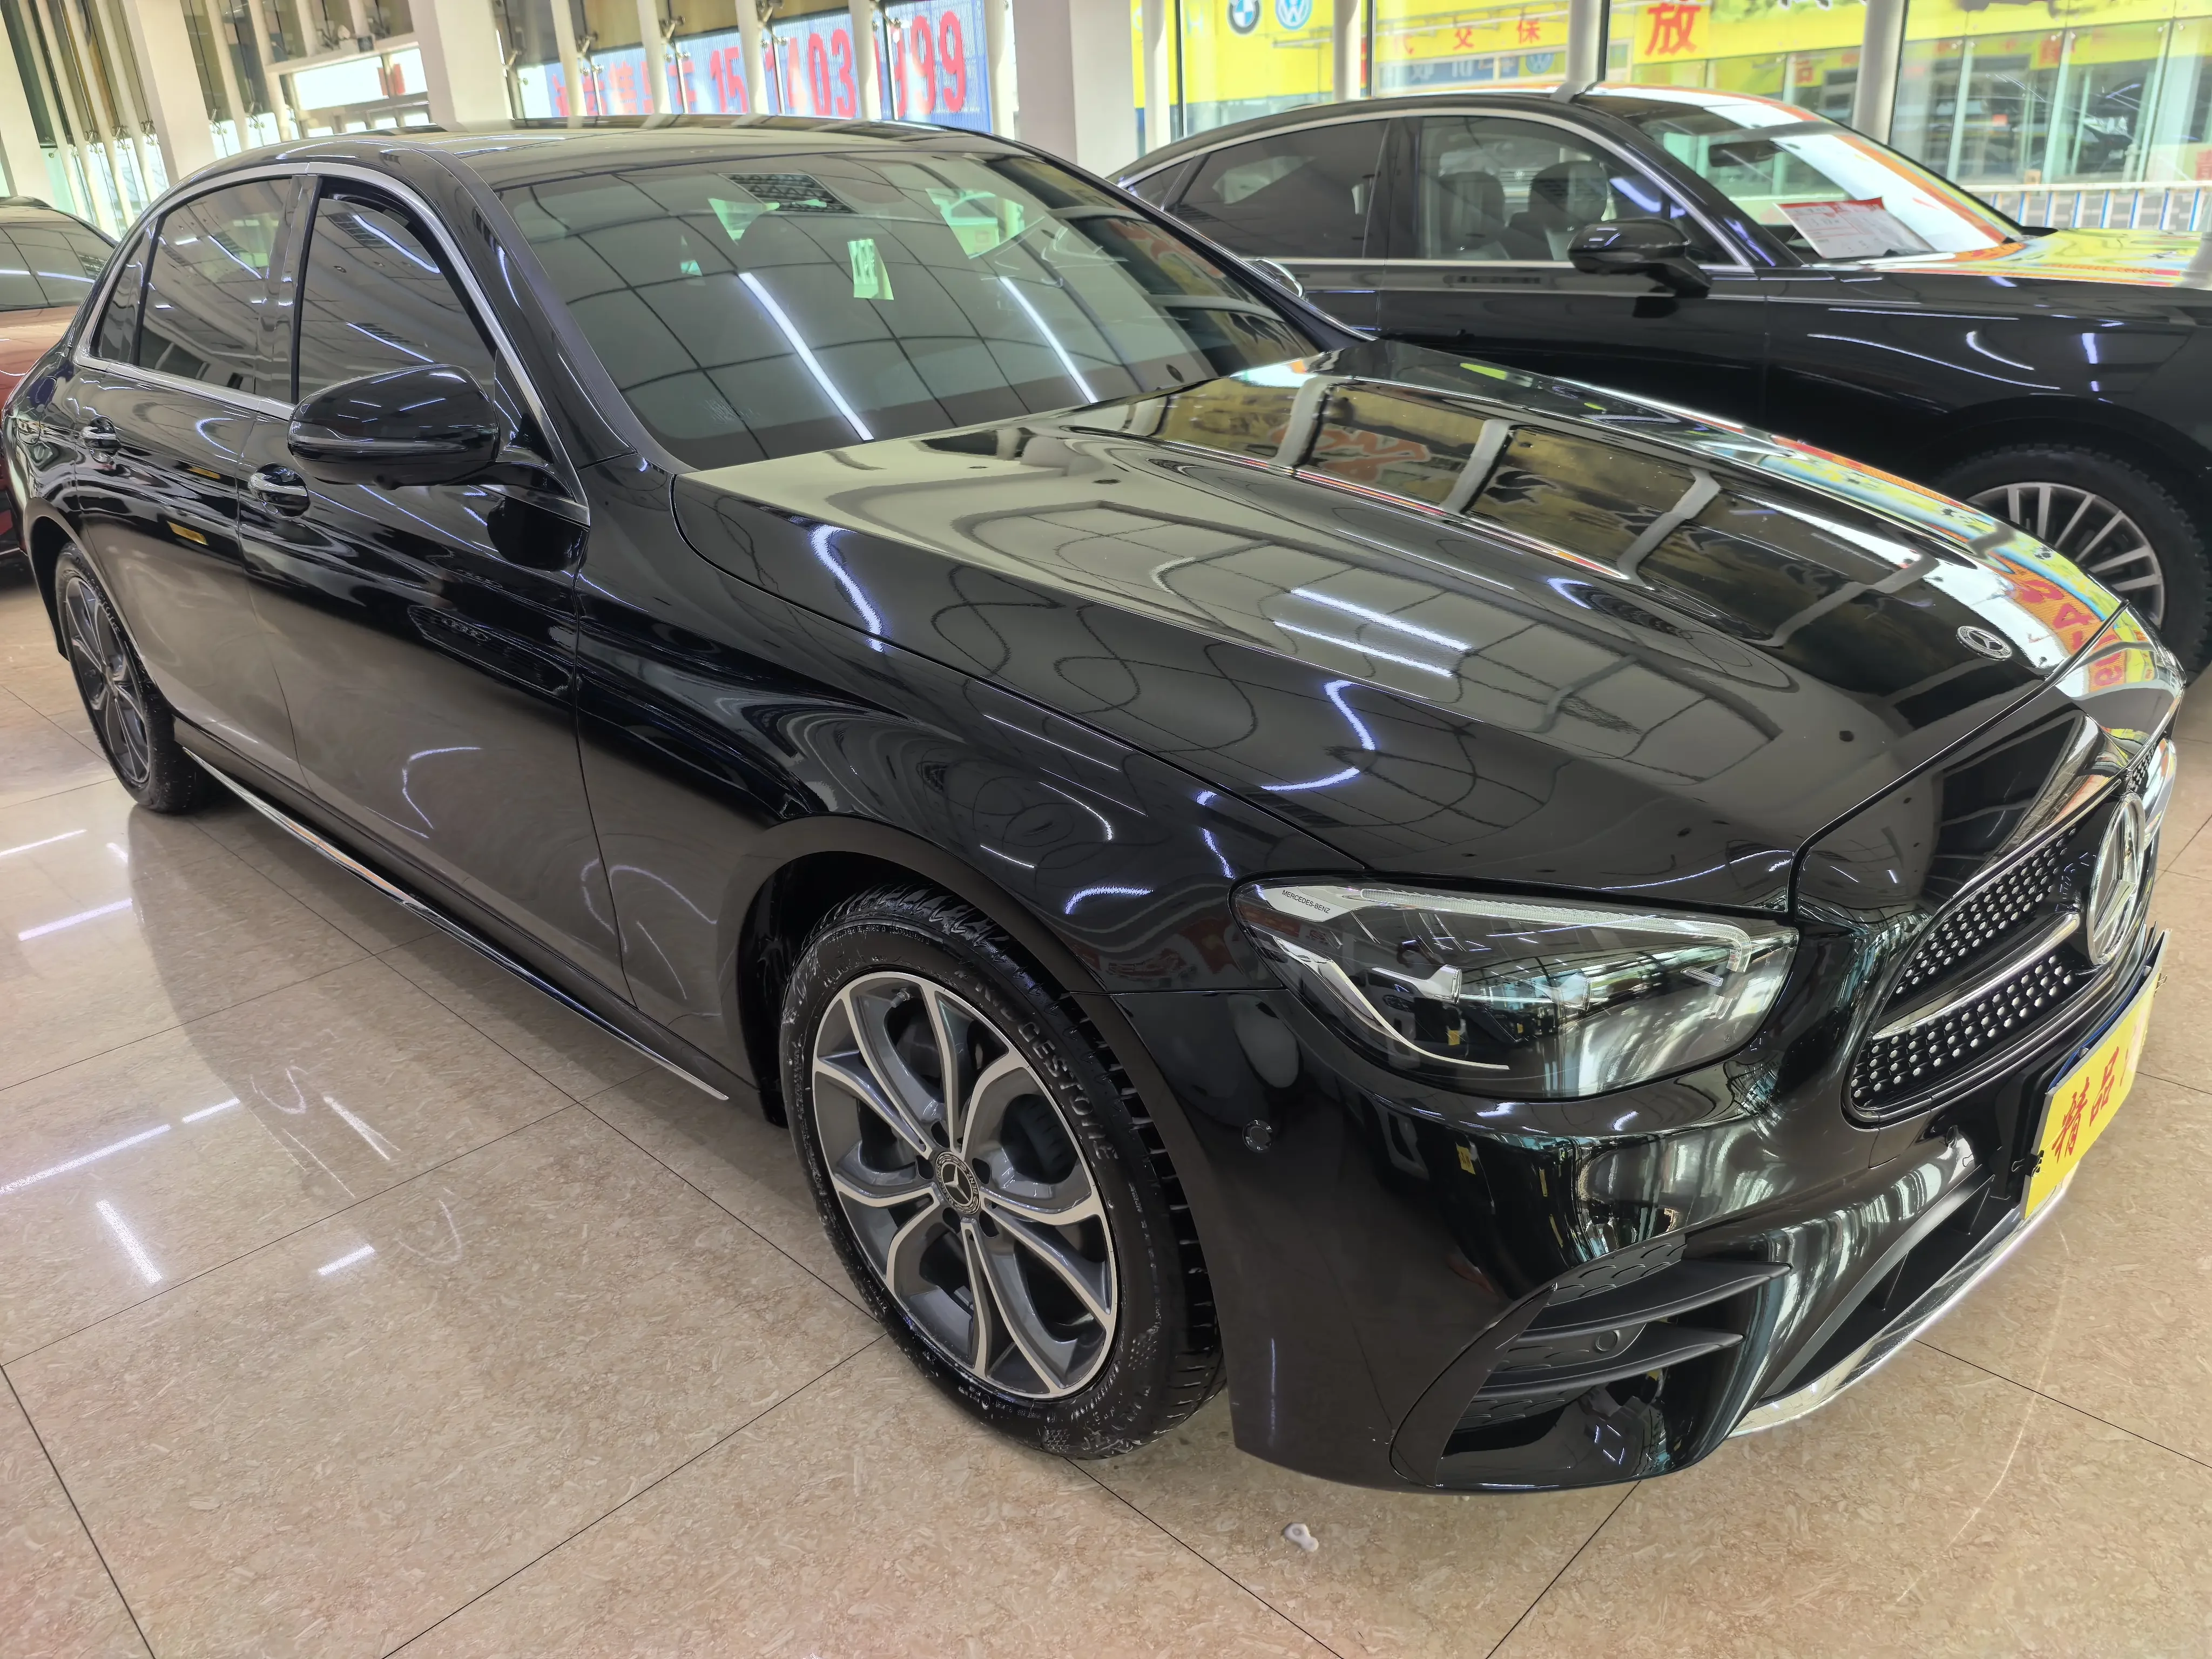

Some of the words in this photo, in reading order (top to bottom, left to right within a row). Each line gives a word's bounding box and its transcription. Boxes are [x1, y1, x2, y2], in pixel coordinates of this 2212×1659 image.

[1644, 3, 1702, 56] 放
[1282, 889, 1331, 914] MERCEDES-BENZ
[966, 1173, 979, 1195] BENZ
